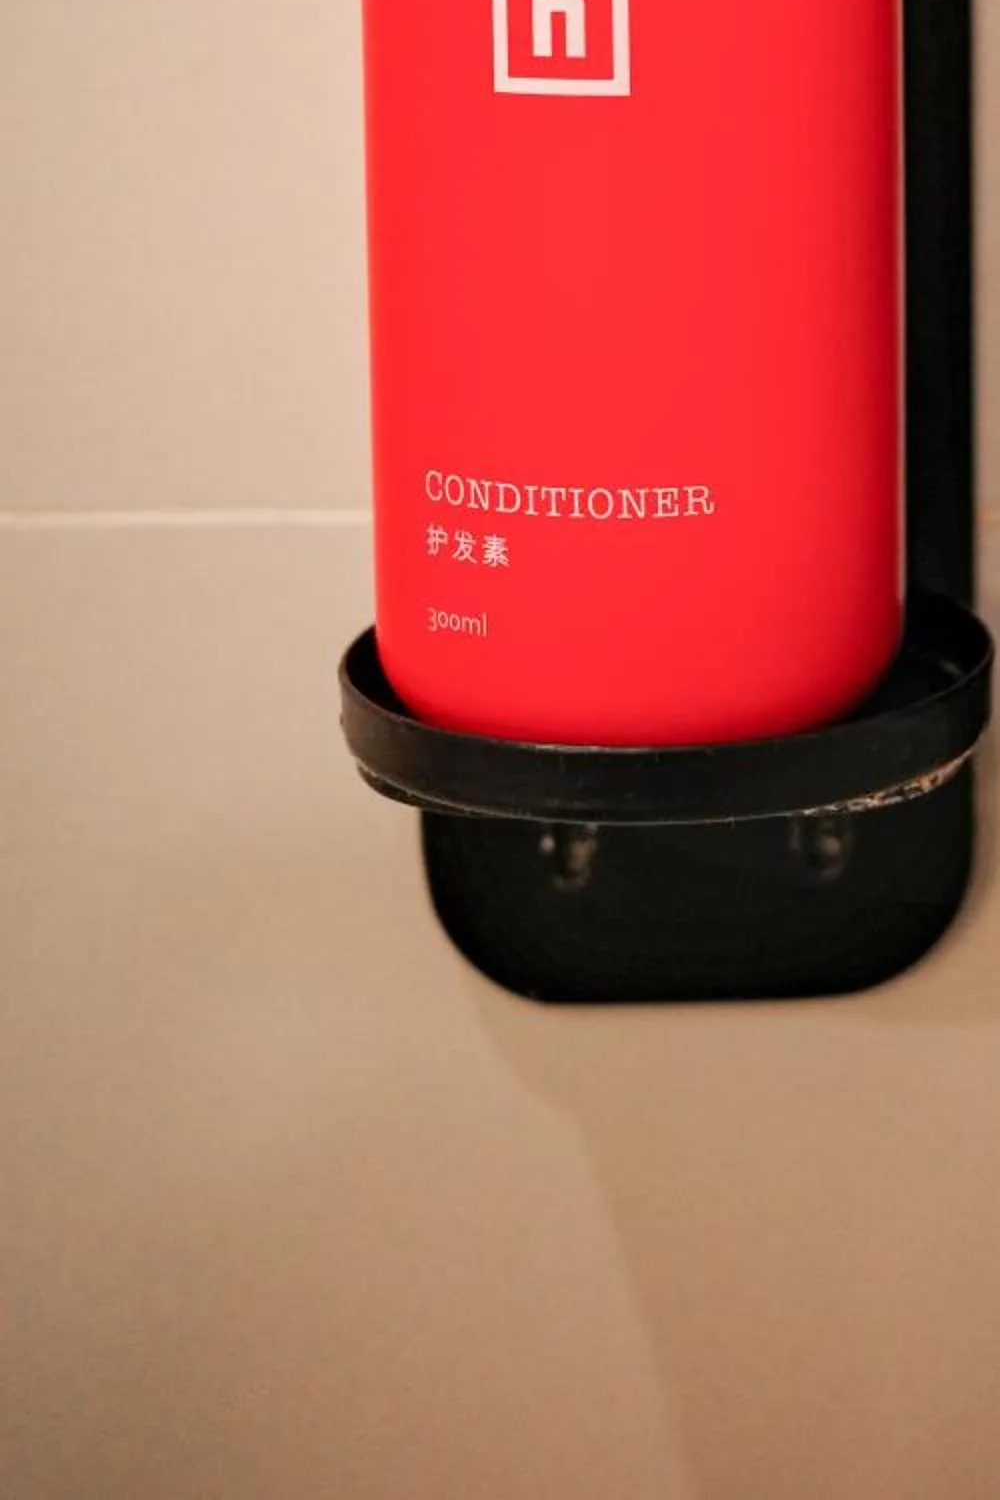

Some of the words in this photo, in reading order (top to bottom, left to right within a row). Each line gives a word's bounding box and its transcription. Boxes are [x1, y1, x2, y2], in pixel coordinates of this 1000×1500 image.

[424, 469, 715, 520] CONDITIONER
[425, 522, 510, 568] 护发素
[426, 606, 488, 637] 300ml
